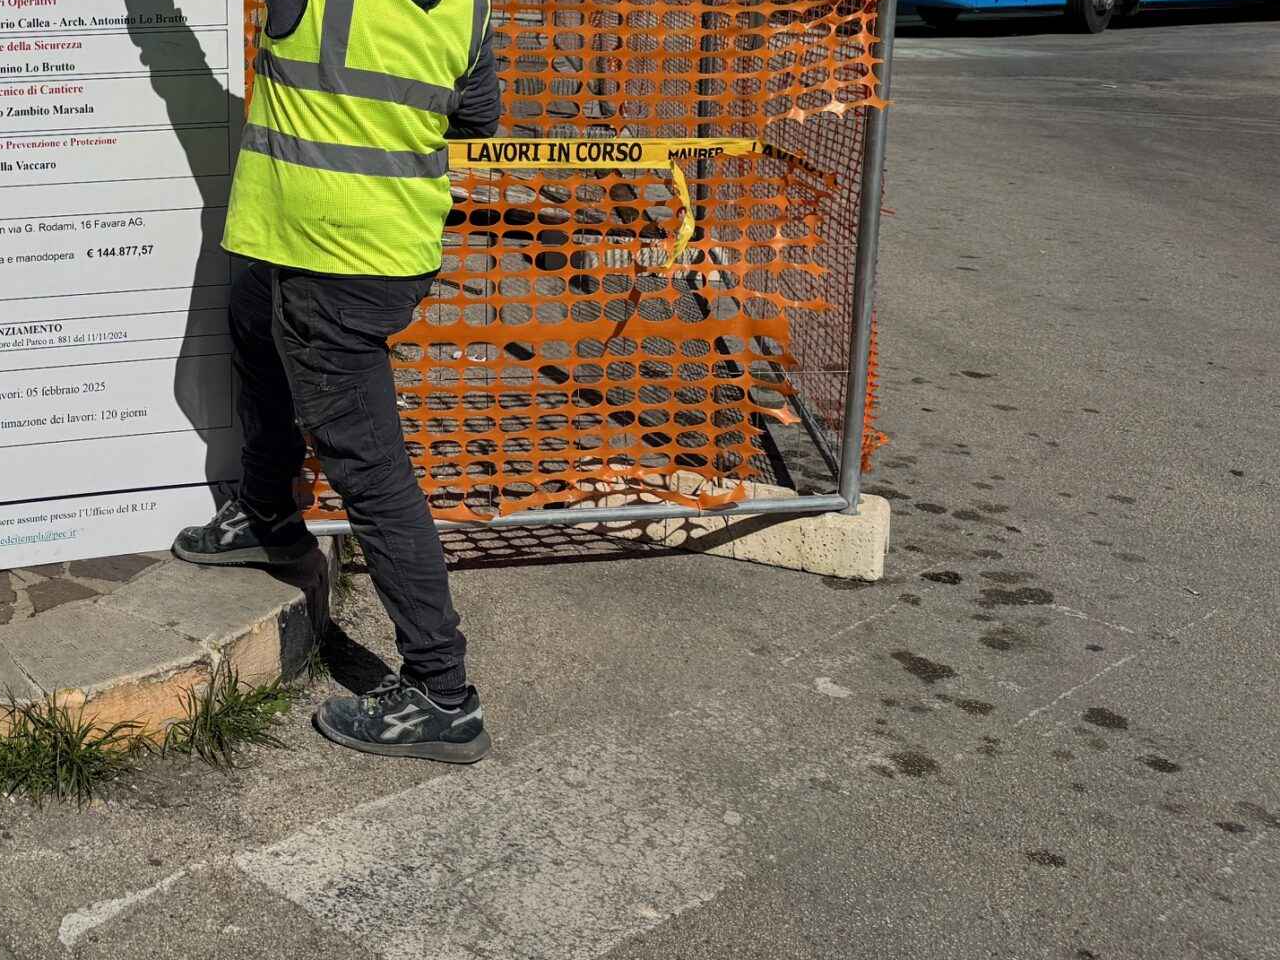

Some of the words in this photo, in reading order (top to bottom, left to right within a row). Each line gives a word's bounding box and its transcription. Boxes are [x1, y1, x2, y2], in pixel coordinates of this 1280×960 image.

[17, 17, 51, 29] Callea
[58, 16, 87, 28] Arch.
[6, 40, 31, 52] della
[33, 39, 82, 50] Sicurezza
[25, 62, 39, 73] Lo
[41, 61, 76, 73] Brutto
[26, 83, 37, 96] di
[39, 83, 84, 95] Cantiere
[5, 105, 50, 117] Zambito
[52, 103, 94, 115] Marsala
[5, 138, 61, 152] Prevenzione
[69, 136, 117, 147] Protezione
[467, 142, 540, 162] LAVORI
[548, 143, 569, 161] IN
[576, 142, 643, 162] CORSO
[15, 160, 56, 171] Vaccaro
[7, 225, 22, 234] via
[80, 219, 92, 230] 16
[93, 218, 126, 229] Favara
[15, 251, 75, 264] manodopera
[86, 247, 94, 258] €
[96, 244, 154, 258] 144.877,57
[25, 386, 38, 398] 05
[41, 384, 80, 397] febbraio
[82, 381, 106, 393] 2025
[49, 413, 65, 425] dei
[66, 412, 97, 423] lavori:
[101, 408, 118, 420] 120
[119, 407, 147, 421] giorni
